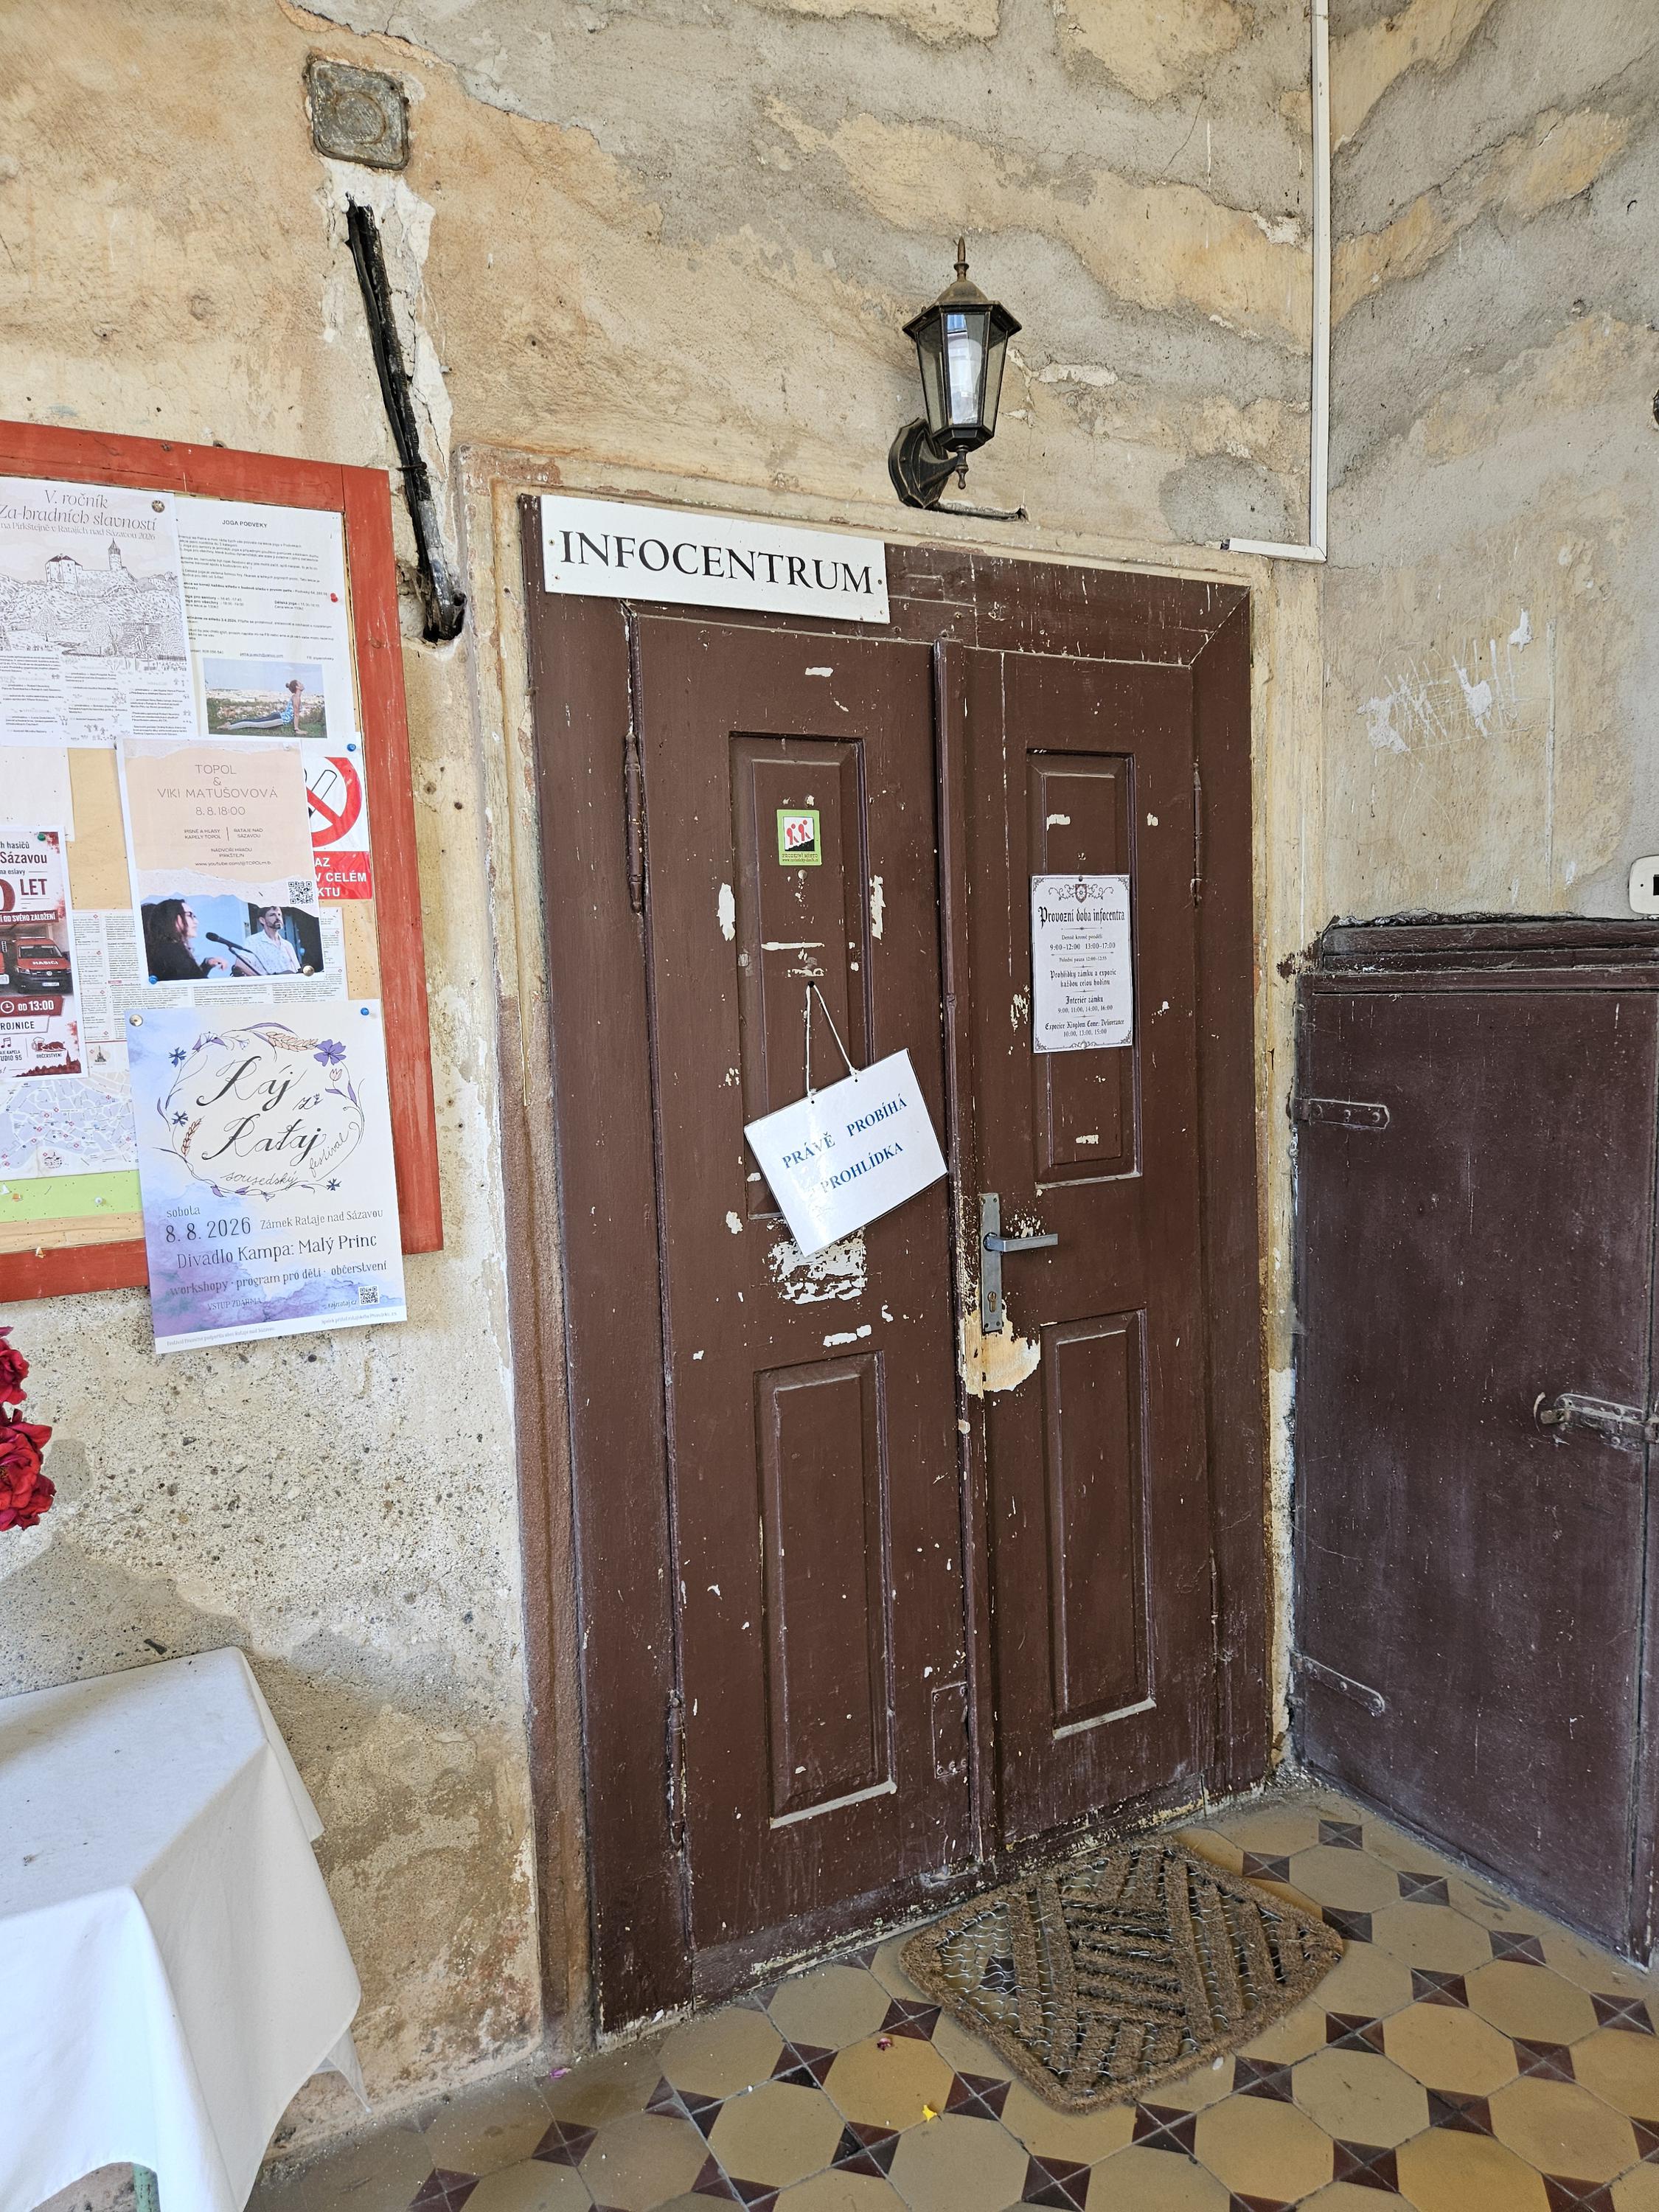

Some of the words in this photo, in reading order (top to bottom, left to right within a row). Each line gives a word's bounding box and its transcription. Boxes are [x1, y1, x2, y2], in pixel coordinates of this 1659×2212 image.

[45, 490, 58, 504] V.
[62, 493, 108, 509] ročník
[93, 512, 157, 531] slavností
[90, 527, 104, 535] nad
[139, 532, 156, 540] 2026
[559, 529, 875, 594] INFOCENTRUM
[195, 764, 237, 774] TOPOL
[213, 776, 221, 786] &
[157, 788, 181, 799] VIKI
[186, 786, 278, 799] MATUŠOVOVÁ
[195, 807, 205, 815] 8.
[206, 807, 217, 815] 8.
[218, 806, 246, 815] 18:00
[0, 851, 47, 863] Sázavou
[326, 870, 366, 882] CELÉM
[20, 878, 48, 895] LET
[12, 914, 30, 922] SVÉHO
[30, 911, 56, 922] ZALOŽENÍ
[1037, 906, 1074, 929] Provozní
[1076, 907, 1091, 922] doba
[1093, 908, 1125, 925] infocentra
[1050, 970, 1077, 981] Prohlídky
[18, 1003, 28, 1011] OD
[29, 1000, 55, 1011] 13:00
[1065, 995, 1087, 1005] Interiér
[1088, 995, 1104, 1003] zámku
[0, 1021, 35, 1031] ROJNICE
[1066, 1020, 1086, 1029] Kingdom
[1100, 1018, 1124, 1026] Deliverance
[782, 1131, 835, 1169] PRÁVĚ
[846, 1093, 908, 1137] PROBÍHÁ
[309, 1131, 349, 1178] festival
[821, 1142, 903, 1194] PROHLÍDKA
[220, 1170, 298, 1188] sousedský
[167, 1207, 201, 1218] sobota
[166, 1224, 181, 1242] 8.
[187, 1222, 201, 1241] 8.
[207, 1217, 251, 1239] 2026
[260, 1217, 293, 1230] Zámek
[295, 1215, 325, 1227] Rataje
[327, 1211, 344, 1222] nad
[347, 1209, 383, 1221] Sázavou
[177, 1249, 234, 1269] Divadlo
[238, 1243, 294, 1262] Kampa:
[299, 1236, 335, 1255] Malý
[338, 1234, 378, 1250] Princ
[169, 1281, 229, 1296] workshopy
[237, 1275, 280, 1290] program
[283, 1271, 299, 1285] pro
[302, 1266, 321, 1279] děti
[331, 1259, 387, 1276] občerstvení
[207, 1301, 231, 1310] VSTUP
[232, 1298, 262, 1307] ZDARMA
